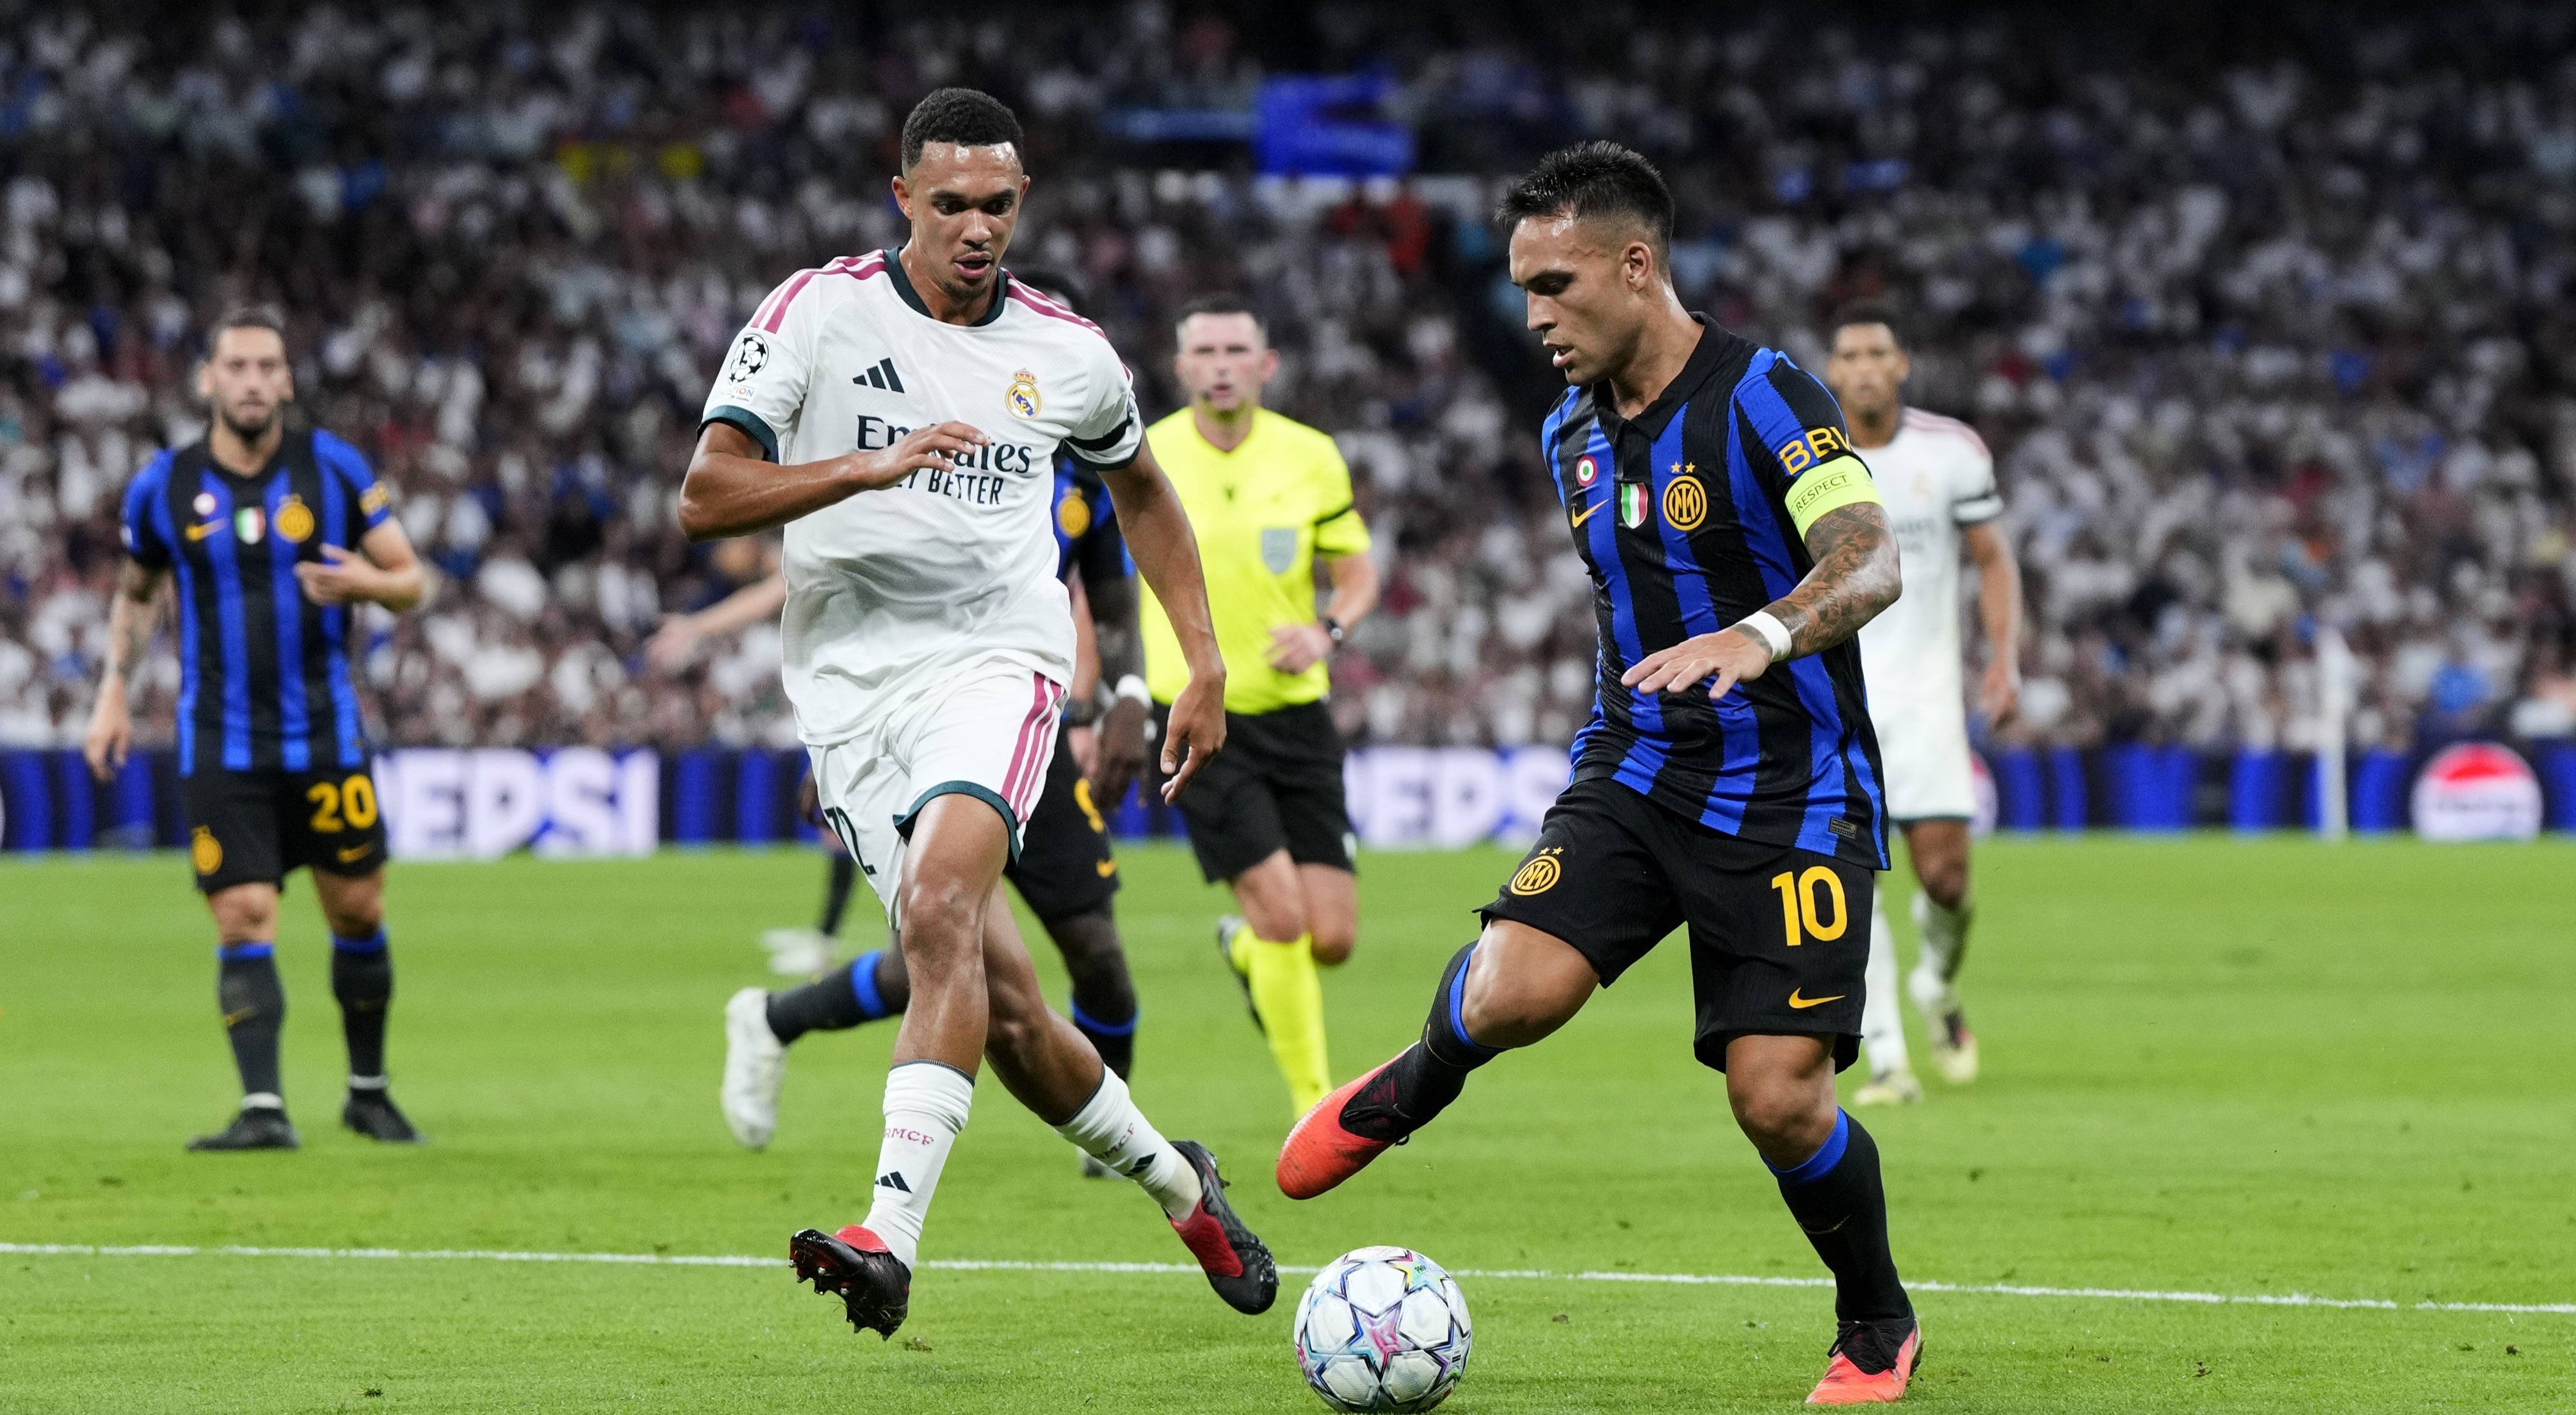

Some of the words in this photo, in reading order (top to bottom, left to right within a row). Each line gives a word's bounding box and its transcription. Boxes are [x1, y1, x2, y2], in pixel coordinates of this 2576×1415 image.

[928, 471, 1004, 504] BETTER
[1795, 475, 1848, 513] RESPECT
[306, 774, 378, 833] 20
[1343, 747, 1571, 851] EPS
[1772, 866, 1848, 946] 10
